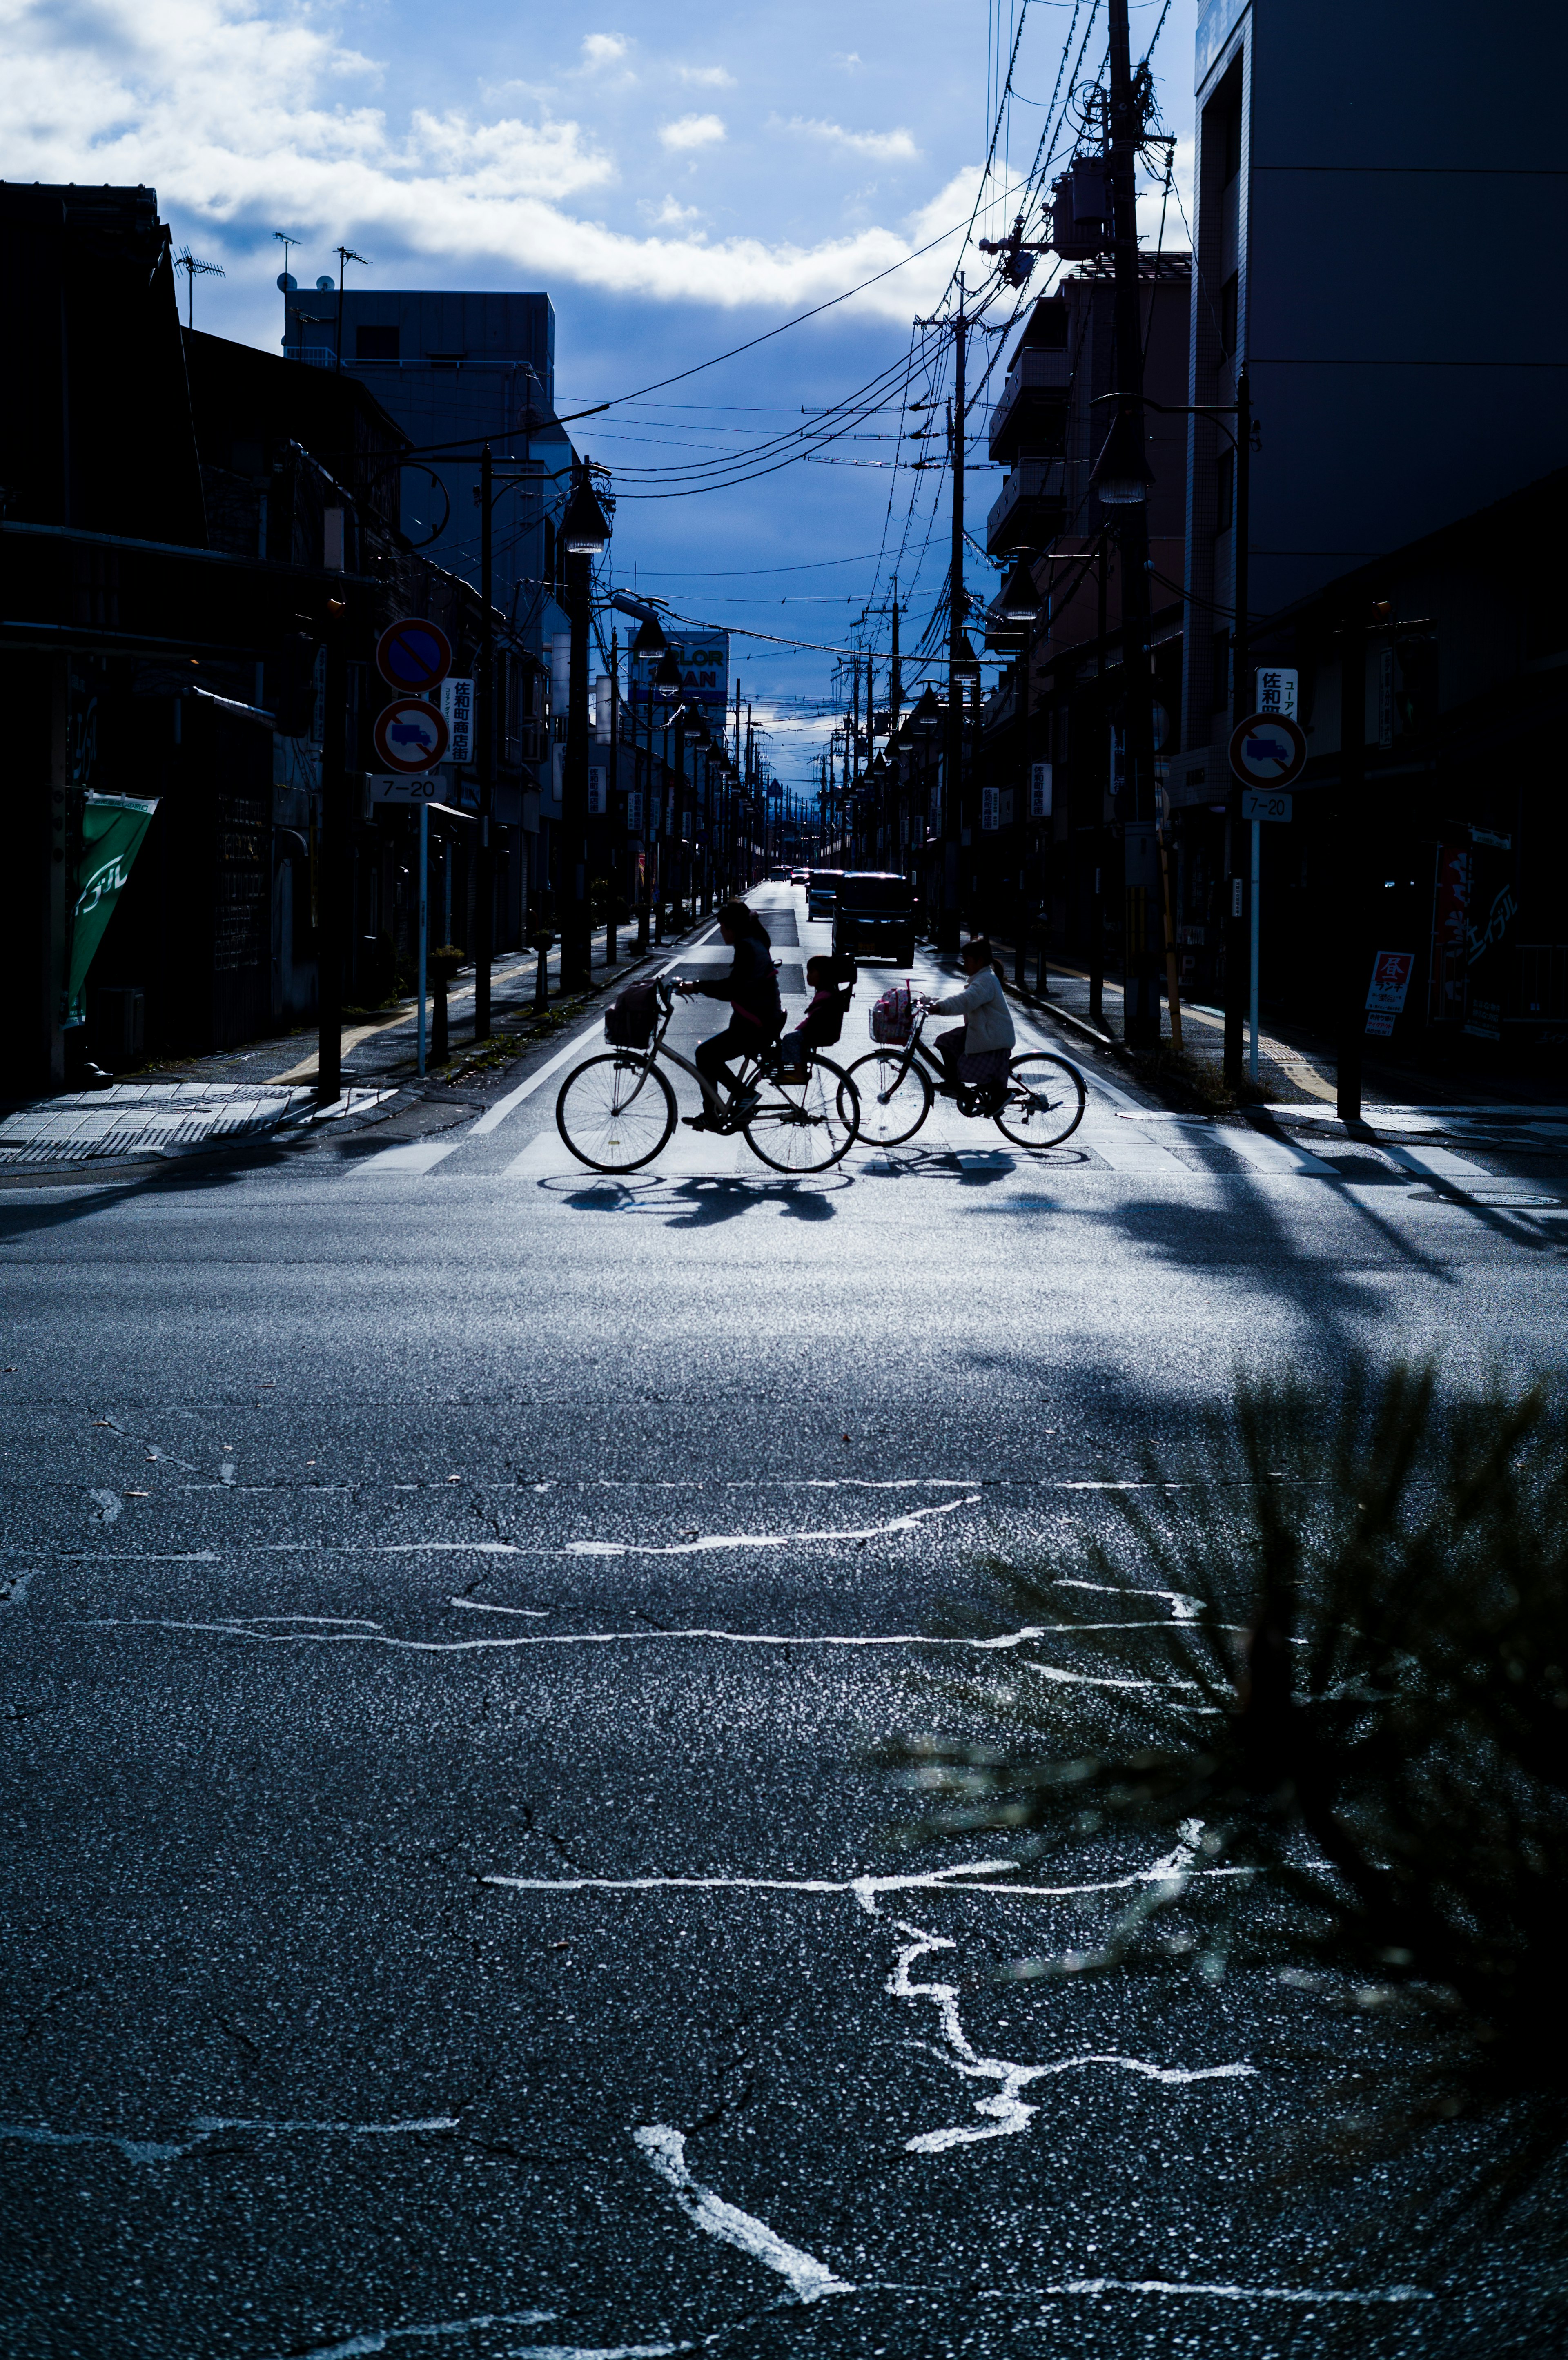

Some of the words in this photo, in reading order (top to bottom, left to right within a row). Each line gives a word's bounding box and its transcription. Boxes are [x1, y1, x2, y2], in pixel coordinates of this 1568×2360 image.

[452, 682, 470, 760] 佐和町商店街
[383, 781, 434, 797] 7-20
[590, 769, 599, 812] 佐和町商店街
[1034, 766, 1044, 814] 佐和町商店街
[94, 799, 148, 811] お部屋探しの窓口
[984, 789, 992, 828] 佐和町商店街
[1250, 797, 1284, 816] 7-20
[1380, 957, 1405, 980] 昼
[1375, 981, 1403, 992] ランチ
[1370, 1014, 1394, 1022] お持ち帰り
